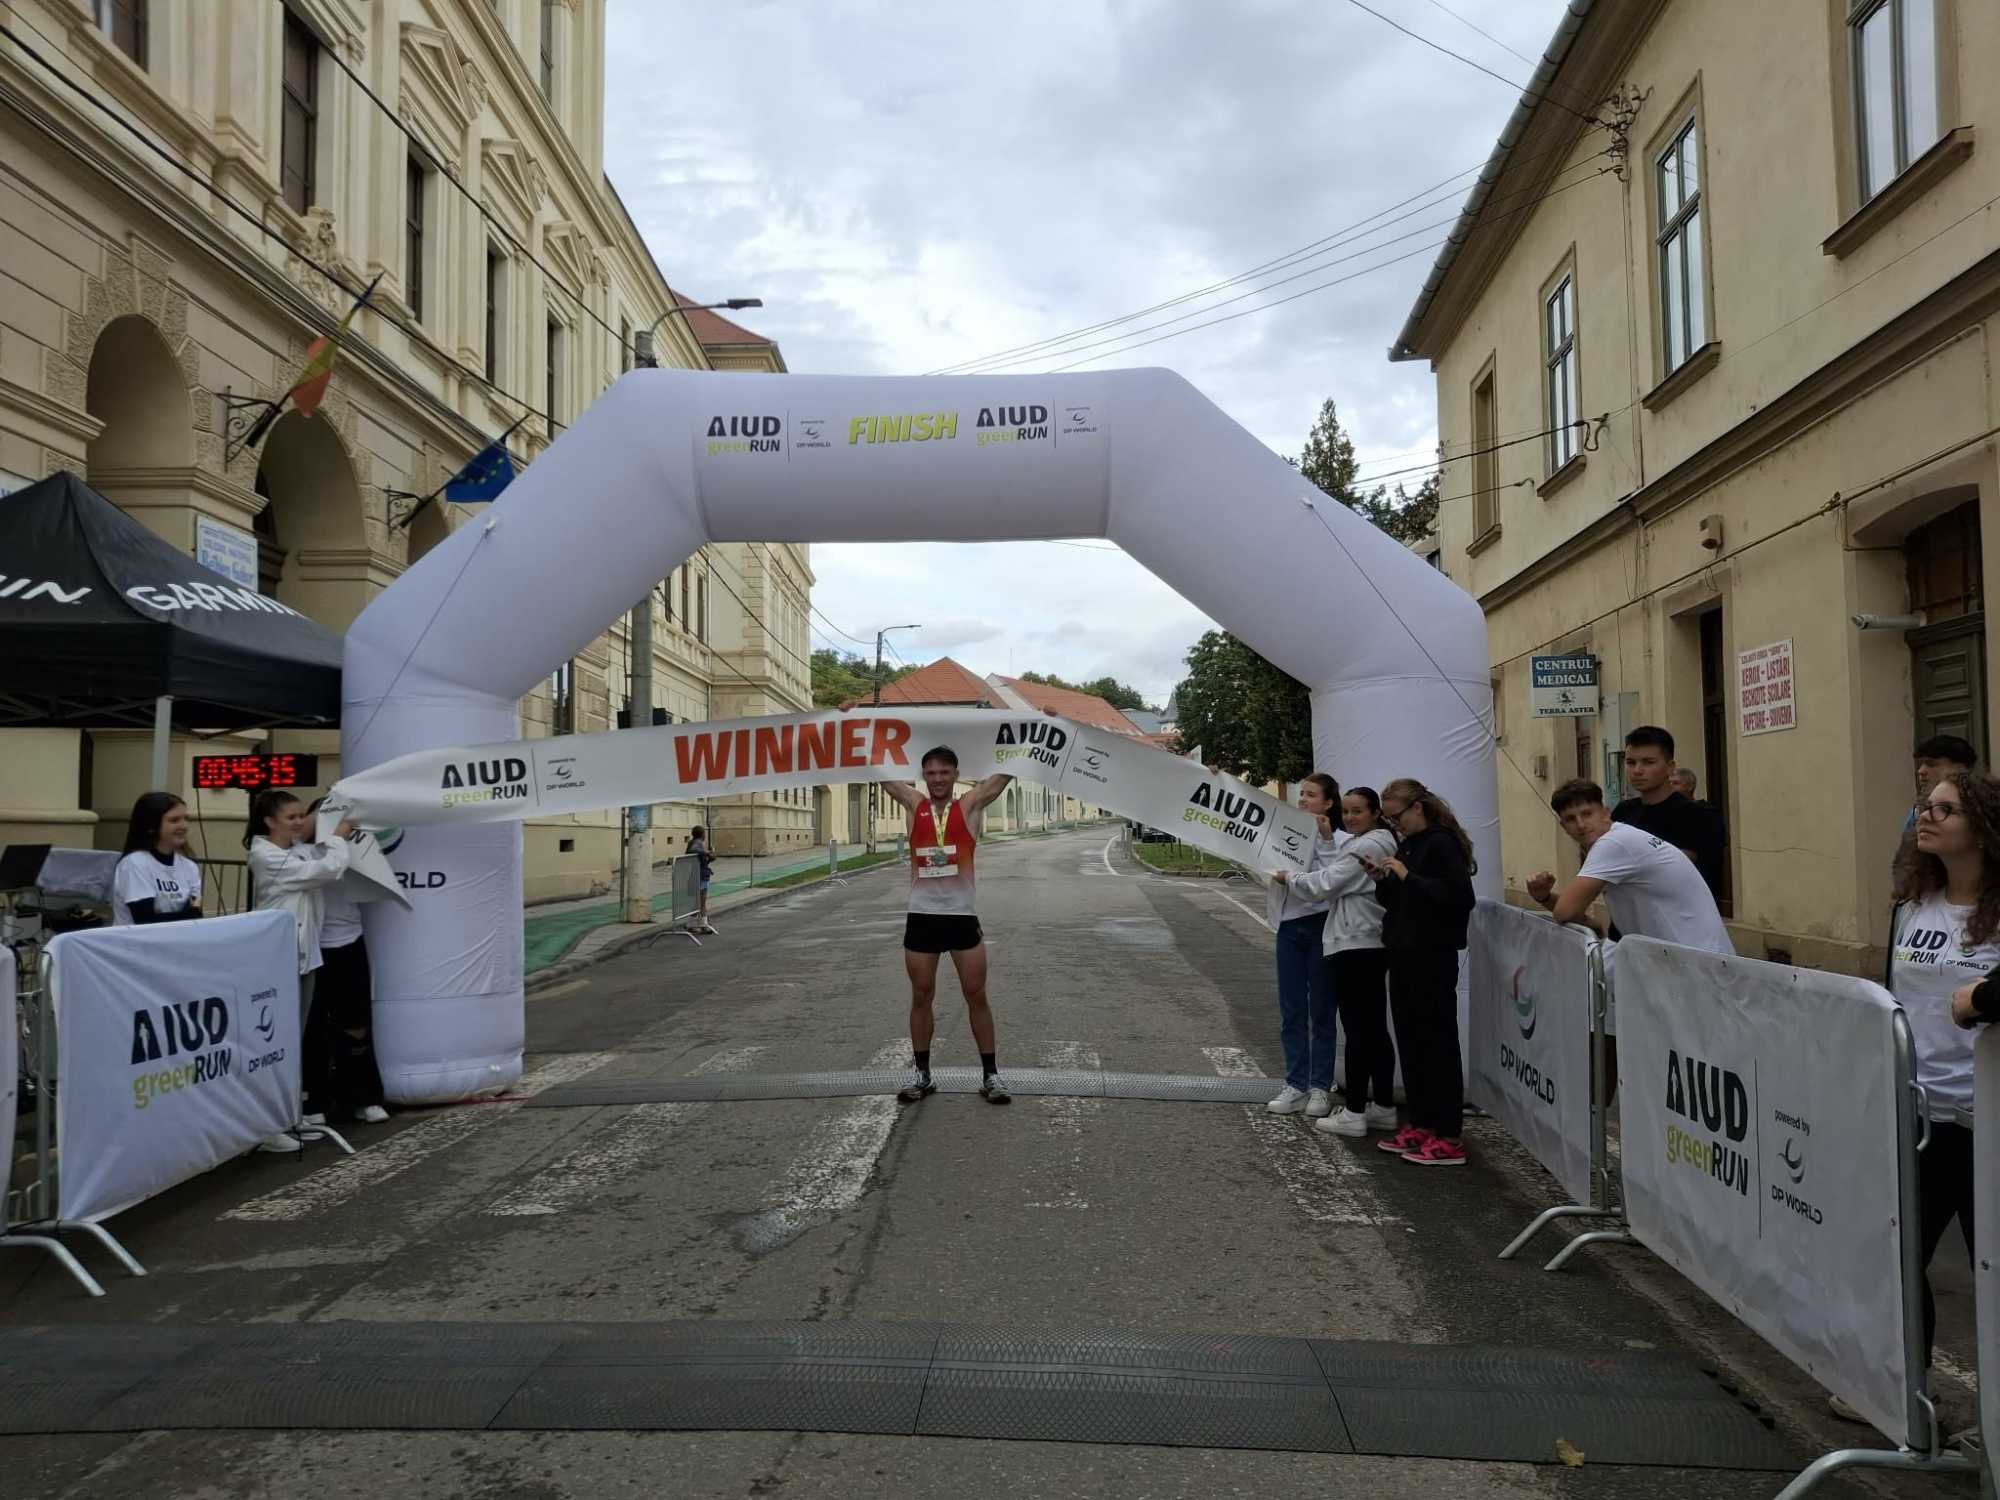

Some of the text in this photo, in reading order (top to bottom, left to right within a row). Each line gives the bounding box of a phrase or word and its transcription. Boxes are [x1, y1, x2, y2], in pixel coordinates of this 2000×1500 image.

[706, 415, 781, 438] AIUD
[848, 409, 958, 445] FINISH
[976, 405, 1048, 428] AIUD
[1535, 659, 1593, 670] CENTRUL
[1537, 673, 1593, 686] MEDICAL
[674, 718, 911, 784] WINNER
[995, 723, 1067, 751] AIUD
[441, 758, 526, 789] AIUD
[1189, 782, 1266, 827] AIUD
[394, 871, 446, 889] RLD
[131, 996, 229, 1065] AIUD
[261, 1048, 285, 1068] WORLD
[1500, 1043, 1555, 1106] DP WORLD
[133, 1048, 231, 1110] greenRUN
[1666, 1049, 1748, 1143] AIUD
[1775, 1109, 1801, 1130] powered
[1666, 1123, 1748, 1196] greenRUN
[1771, 1185, 1823, 1225] DP WORLD
